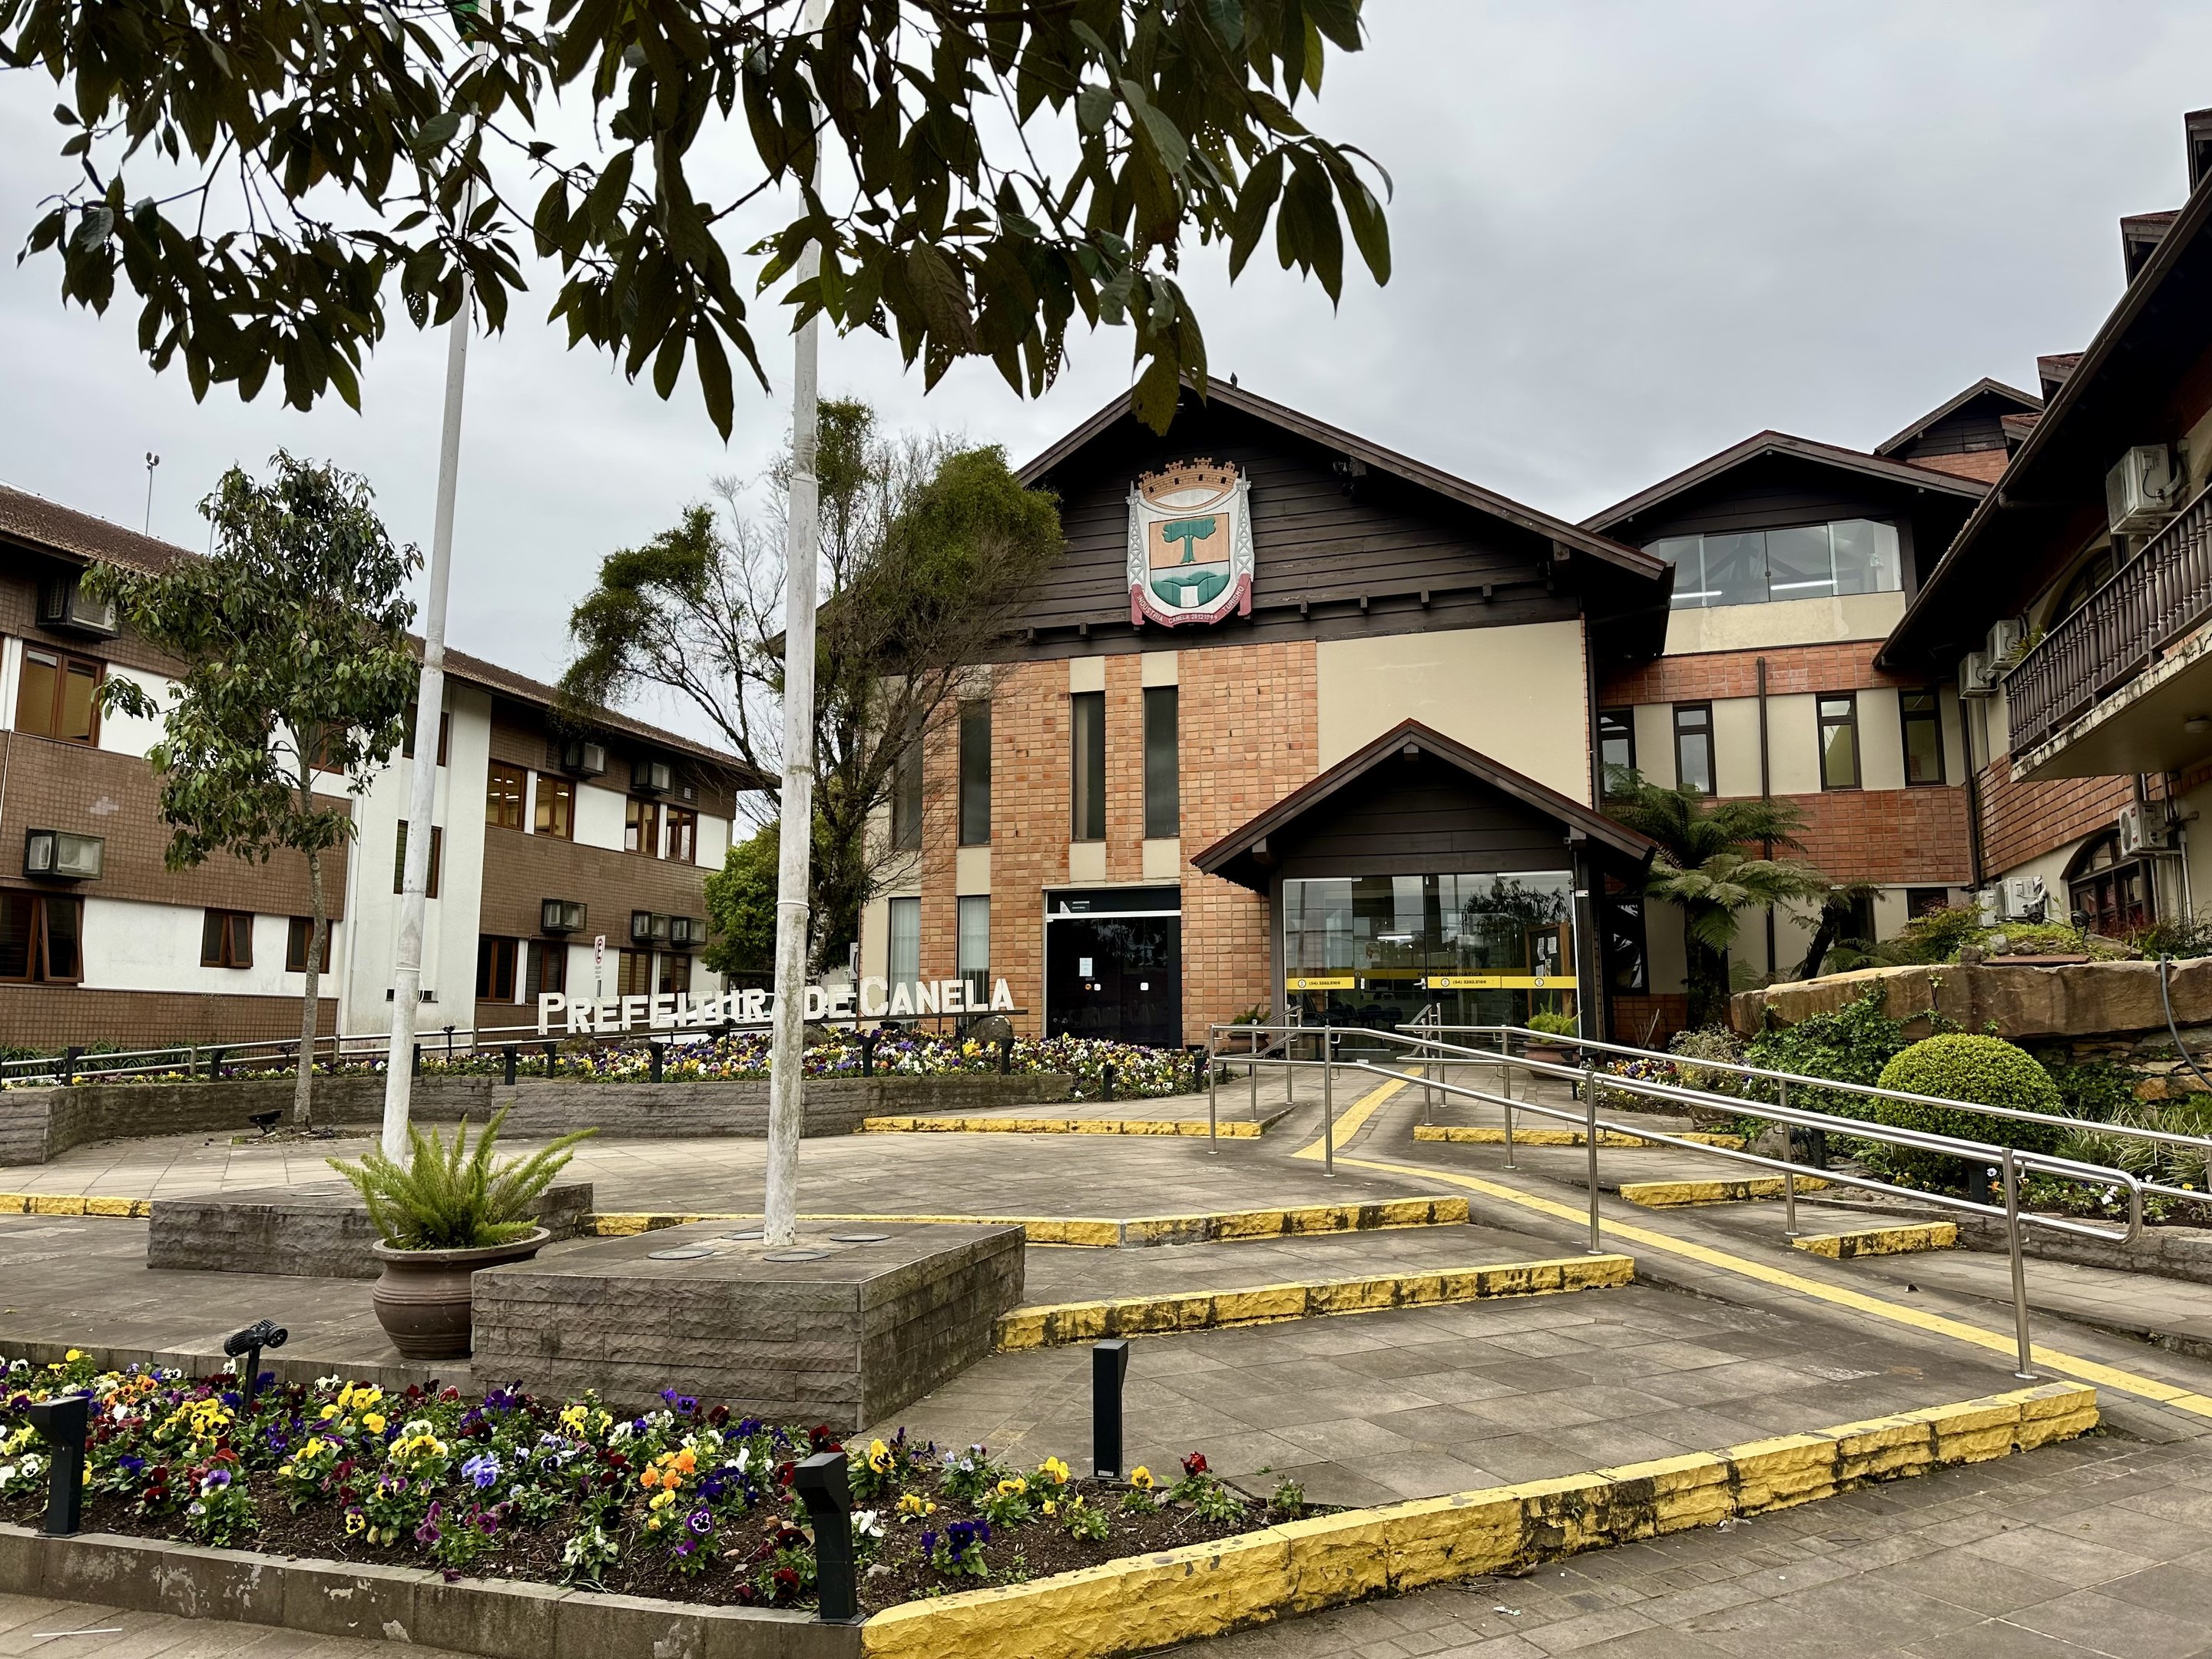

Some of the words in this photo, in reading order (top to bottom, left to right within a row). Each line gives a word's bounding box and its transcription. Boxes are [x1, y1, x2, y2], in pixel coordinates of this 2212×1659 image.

[1221, 585, 1244, 613] TURISMO
[1168, 614, 1190, 624] CANELA
[803, 984, 852, 1020] DE
[859, 975, 1015, 1017] CANELA
